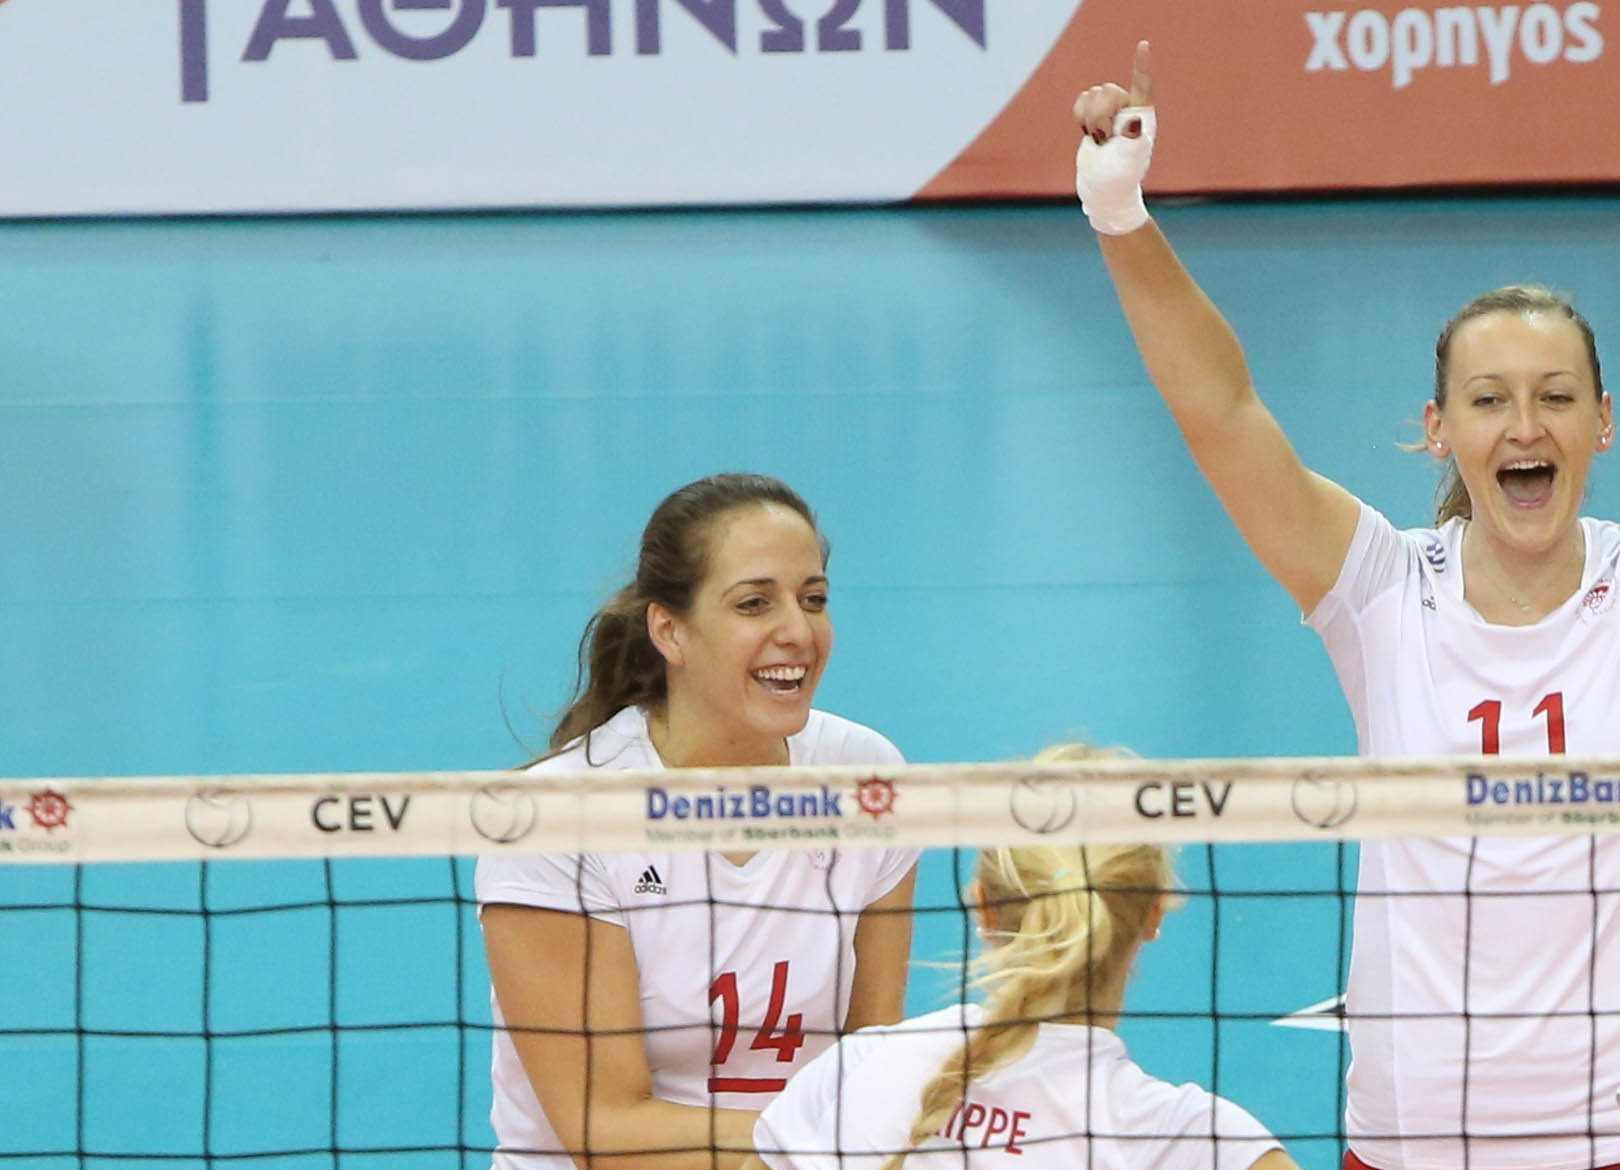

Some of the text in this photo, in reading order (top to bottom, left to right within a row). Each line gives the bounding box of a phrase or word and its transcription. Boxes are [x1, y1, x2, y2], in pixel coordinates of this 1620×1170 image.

[313, 796, 410, 832] CEV
[647, 785, 842, 820] DenizBank
[1135, 782, 1231, 818] CEV
[708, 959, 805, 1065] 14
